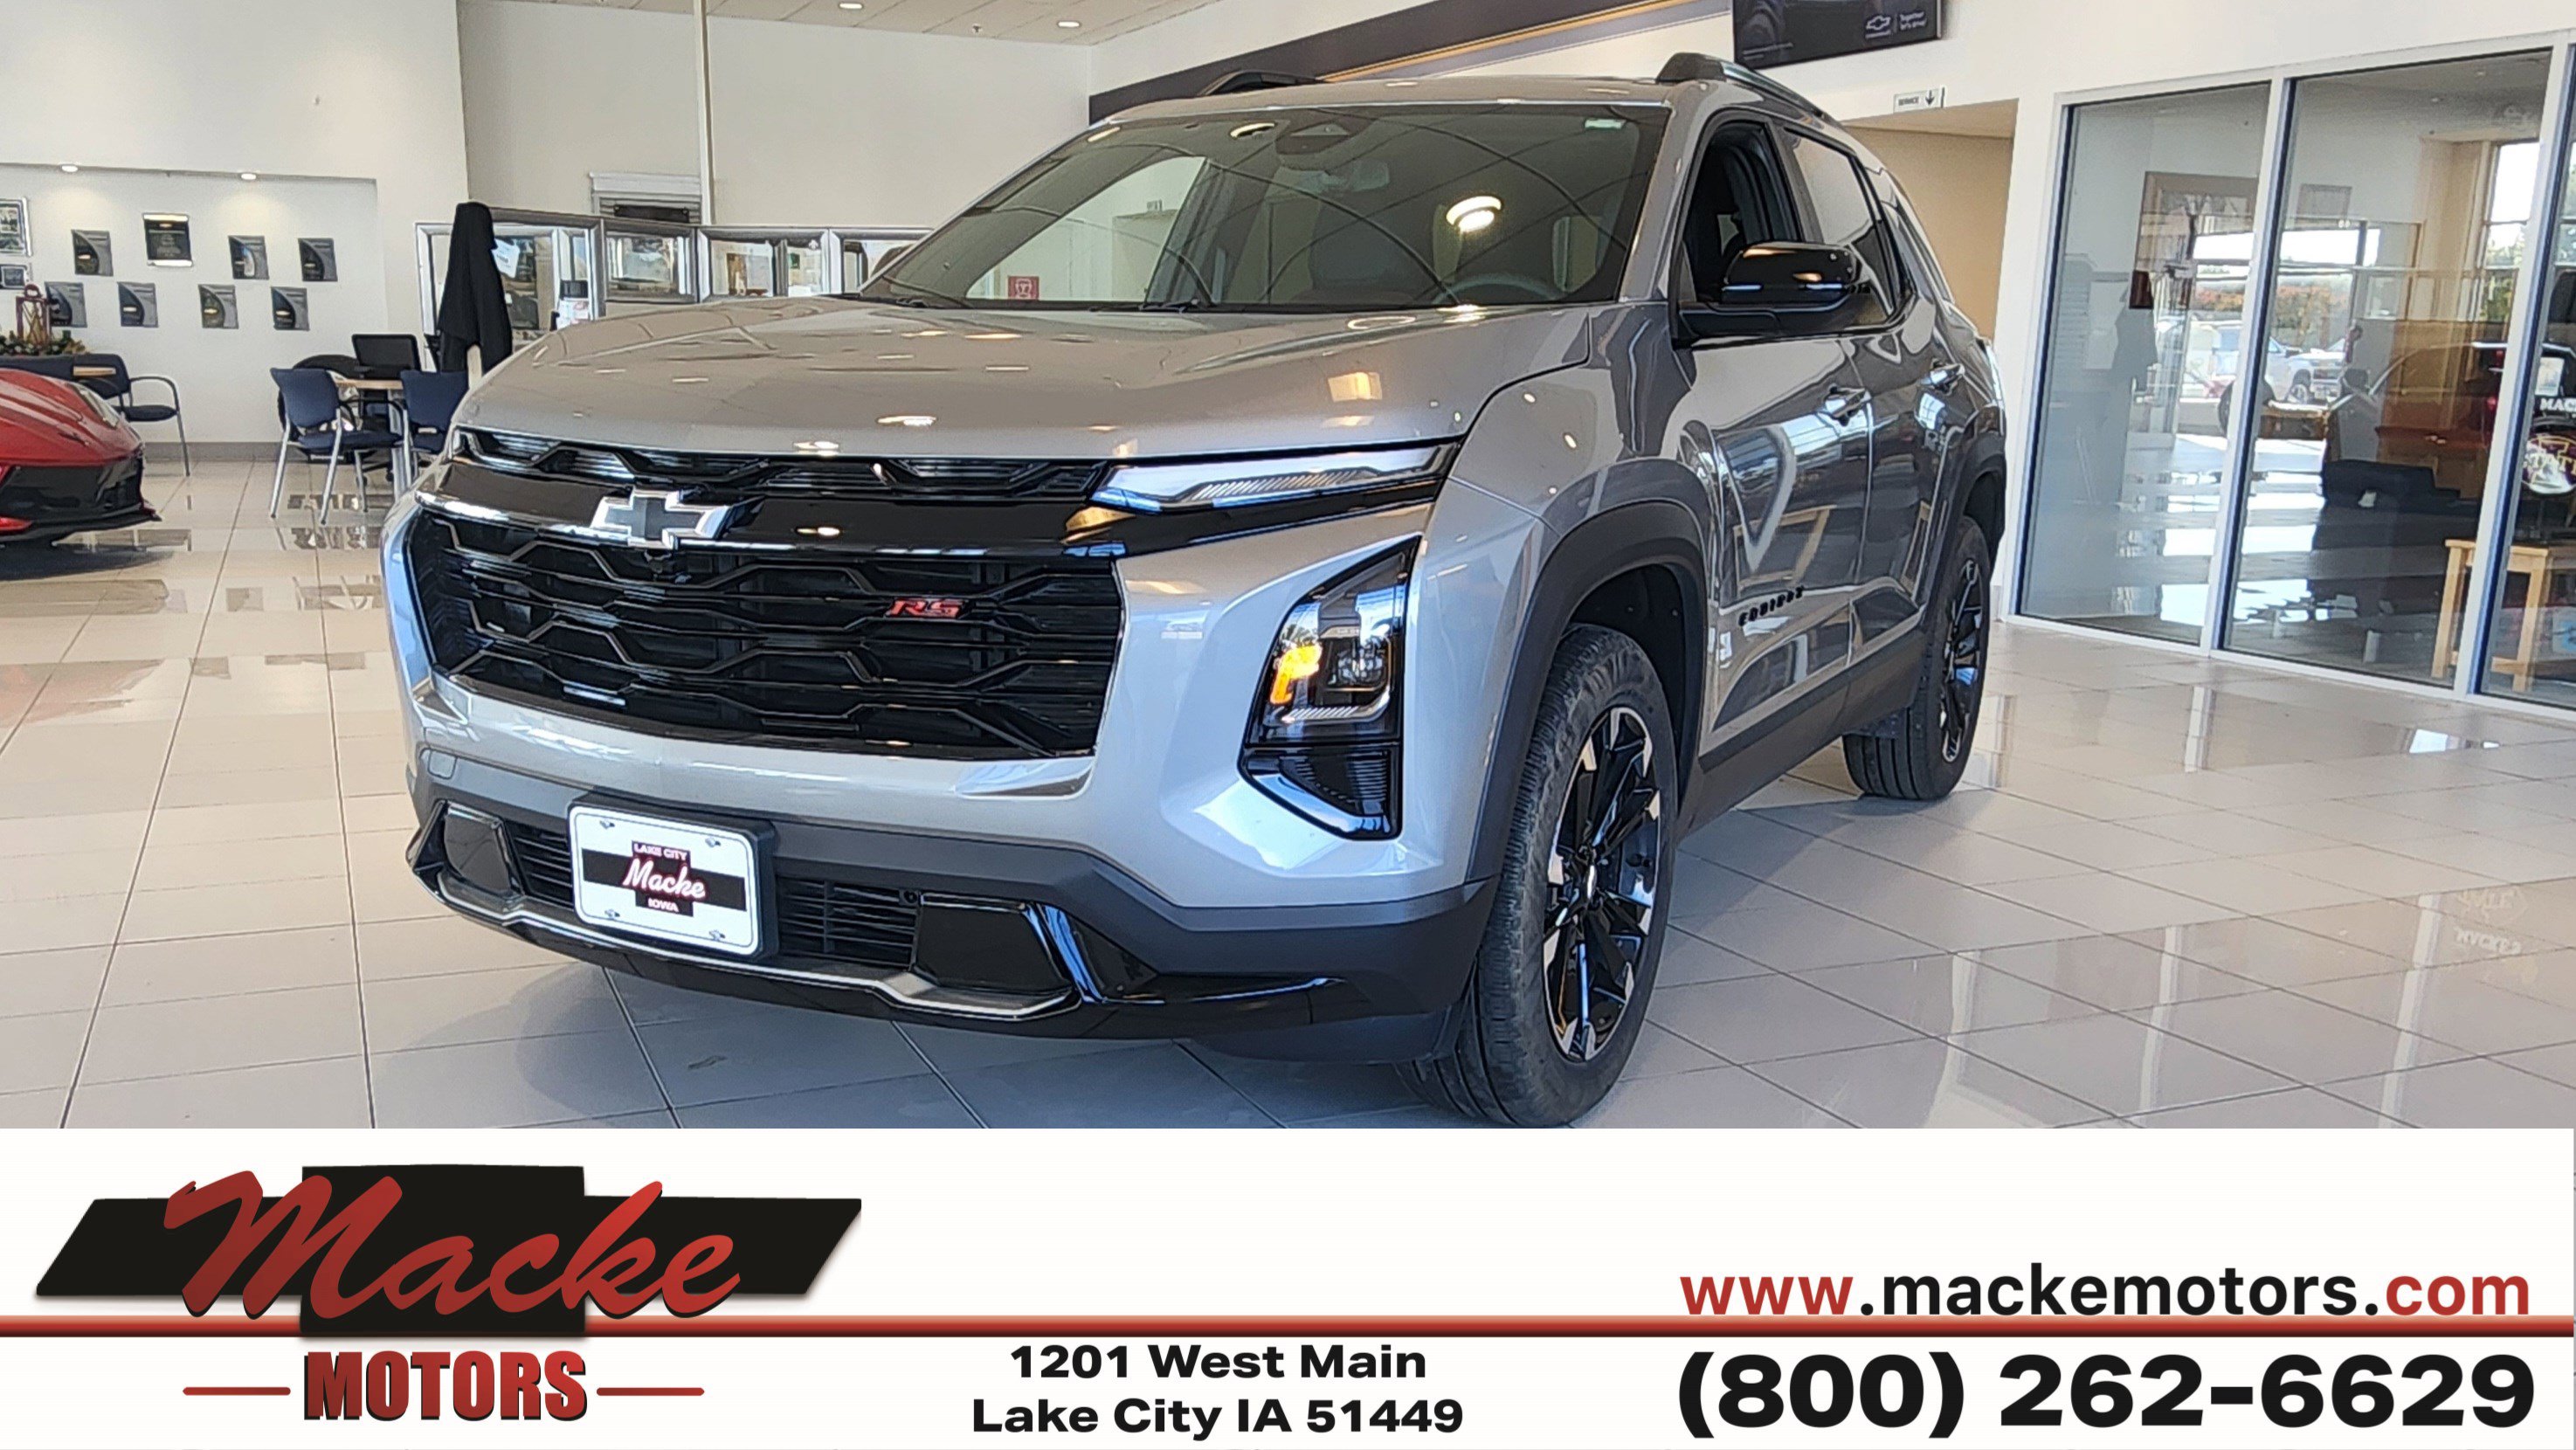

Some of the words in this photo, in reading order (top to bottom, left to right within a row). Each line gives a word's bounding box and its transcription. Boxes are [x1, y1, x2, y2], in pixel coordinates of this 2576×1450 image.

[886, 597, 966, 618] RS
[633, 843, 663, 857] LAKE
[664, 848, 687, 861] CITY
[622, 857, 706, 899] Macke
[647, 898, 680, 913] IOWA
